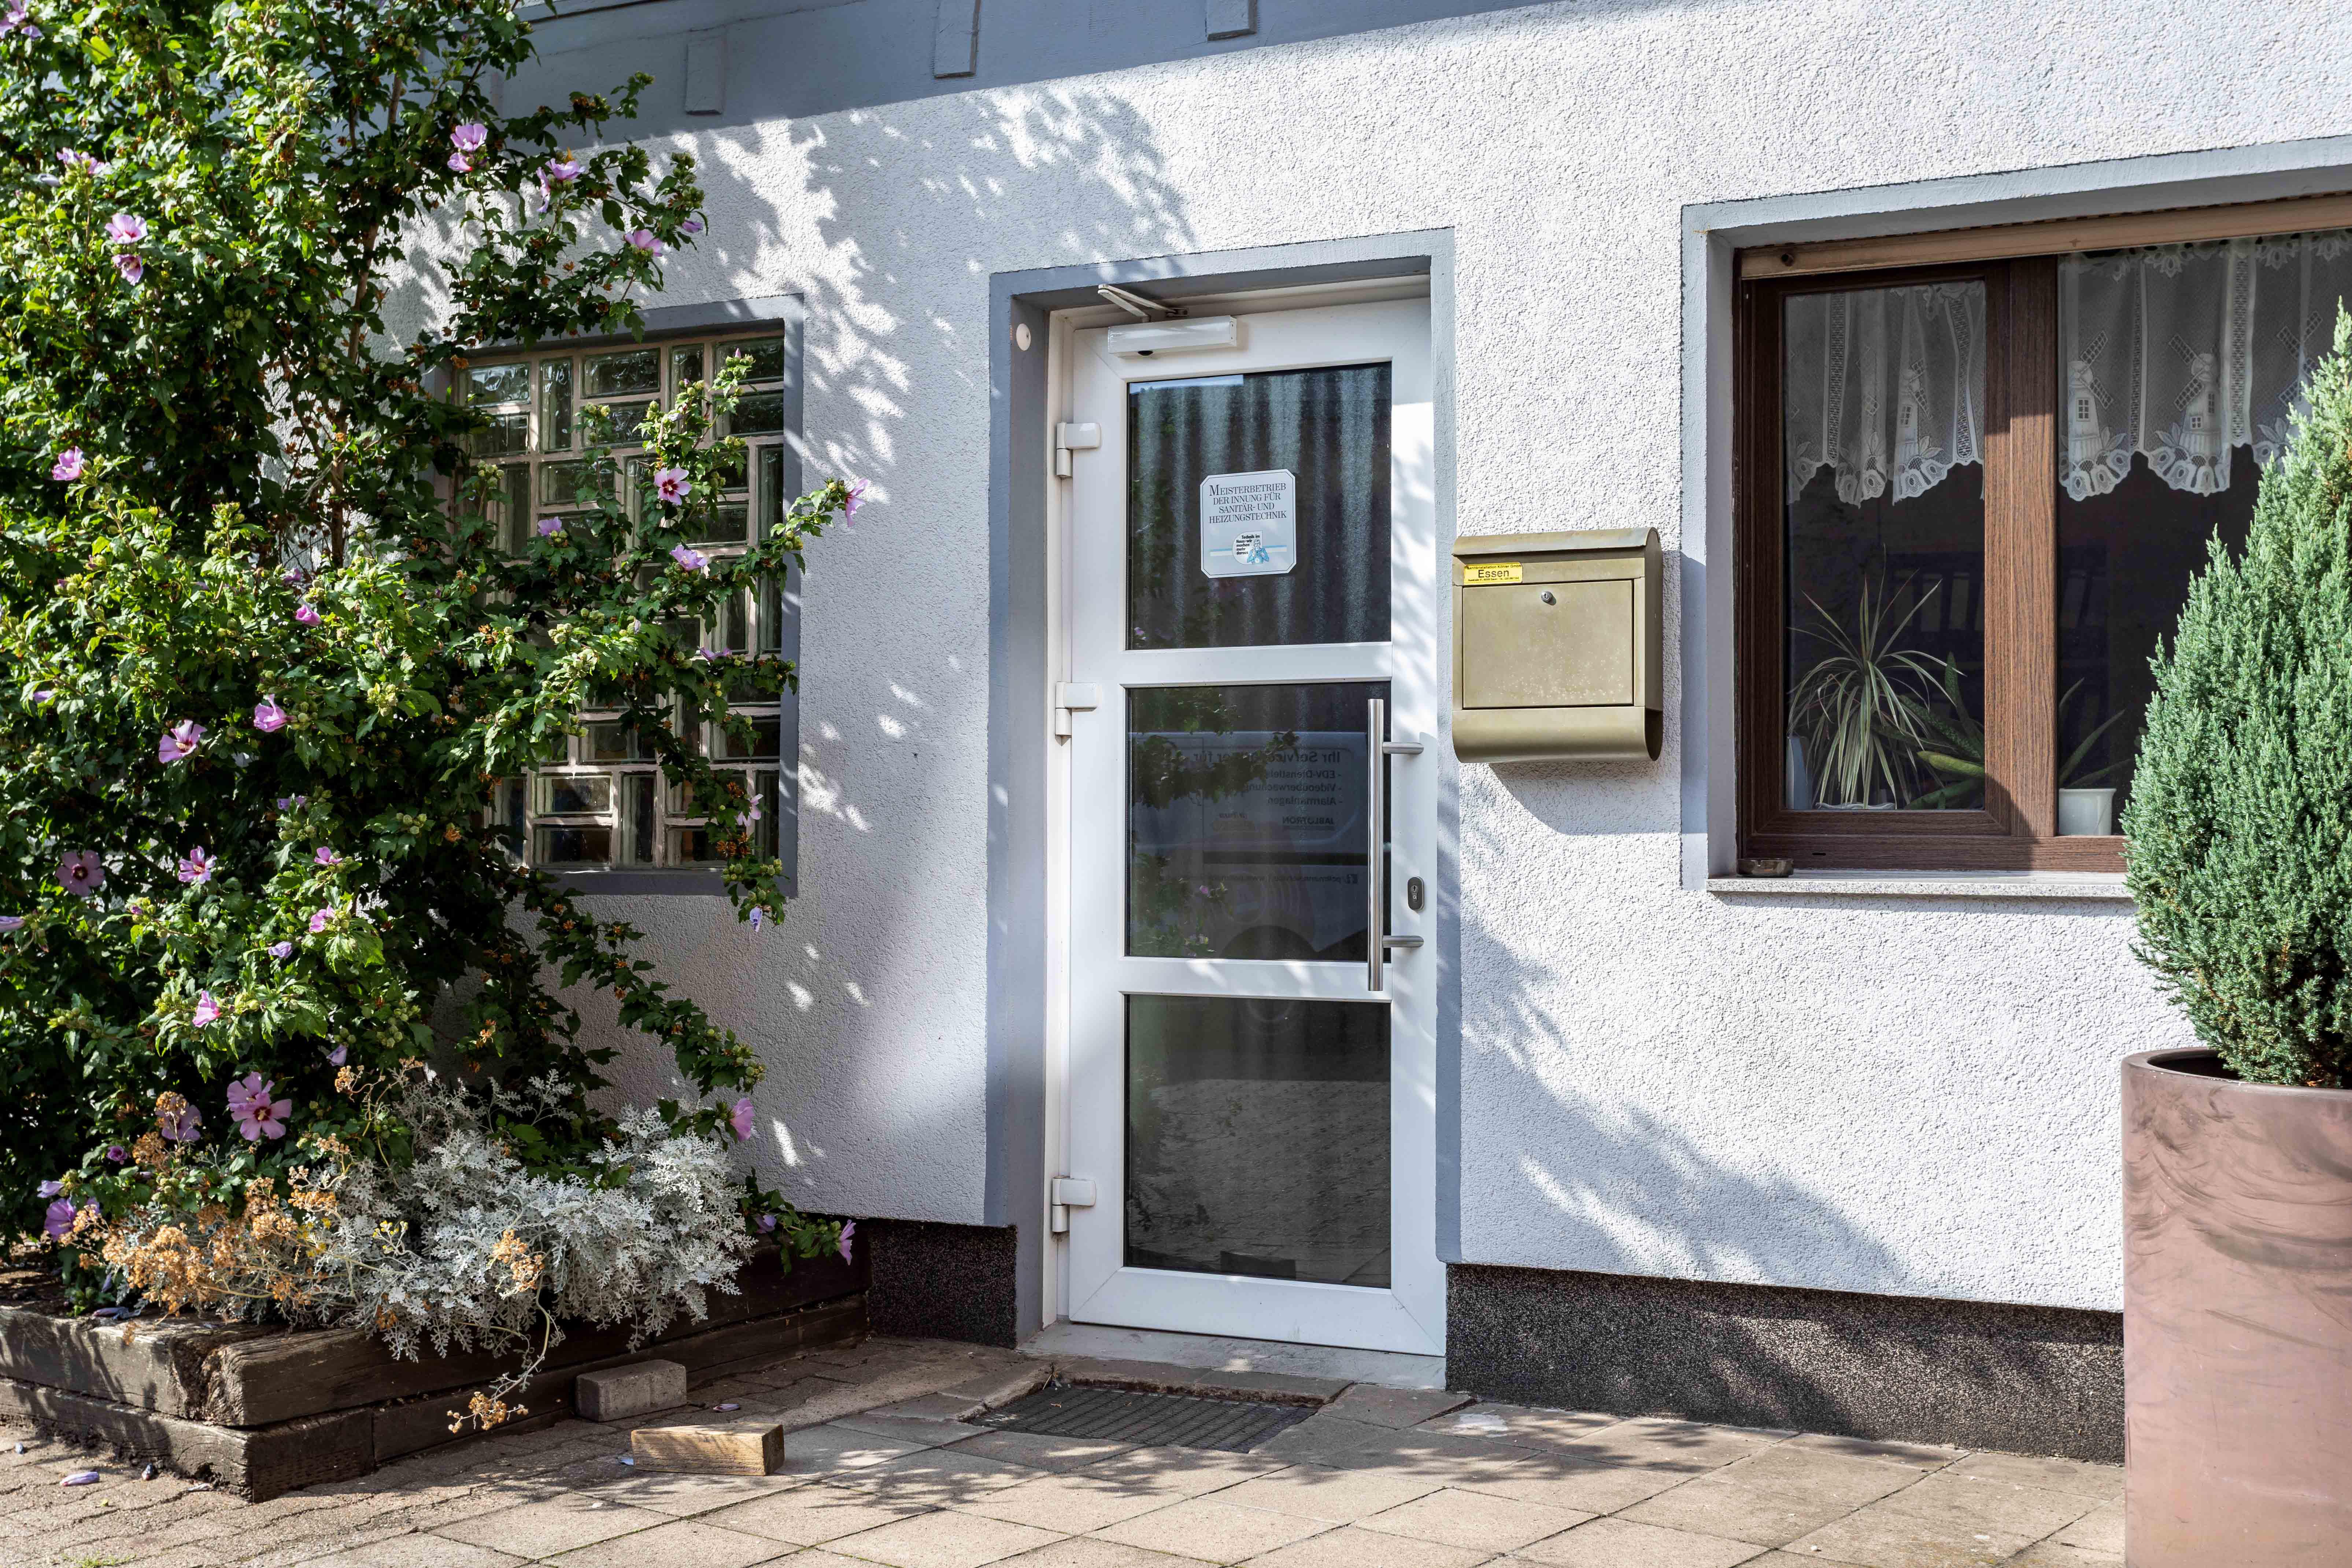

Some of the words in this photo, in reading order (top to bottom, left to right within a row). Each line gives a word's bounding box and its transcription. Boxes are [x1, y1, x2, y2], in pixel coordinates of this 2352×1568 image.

[1209, 483, 1286, 496] MEISTERBETRIEB
[1213, 497, 1229, 505] DER
[1231, 495, 1262, 503] INNUNG
[1265, 492, 1281, 501] FÜR
[1219, 503, 1255, 513] SANITÄR-
[1257, 502, 1274, 511] UND
[1209, 511, 1287, 524] HEIZUNGSTECHNIK
[1478, 570, 1509, 578] Essen
